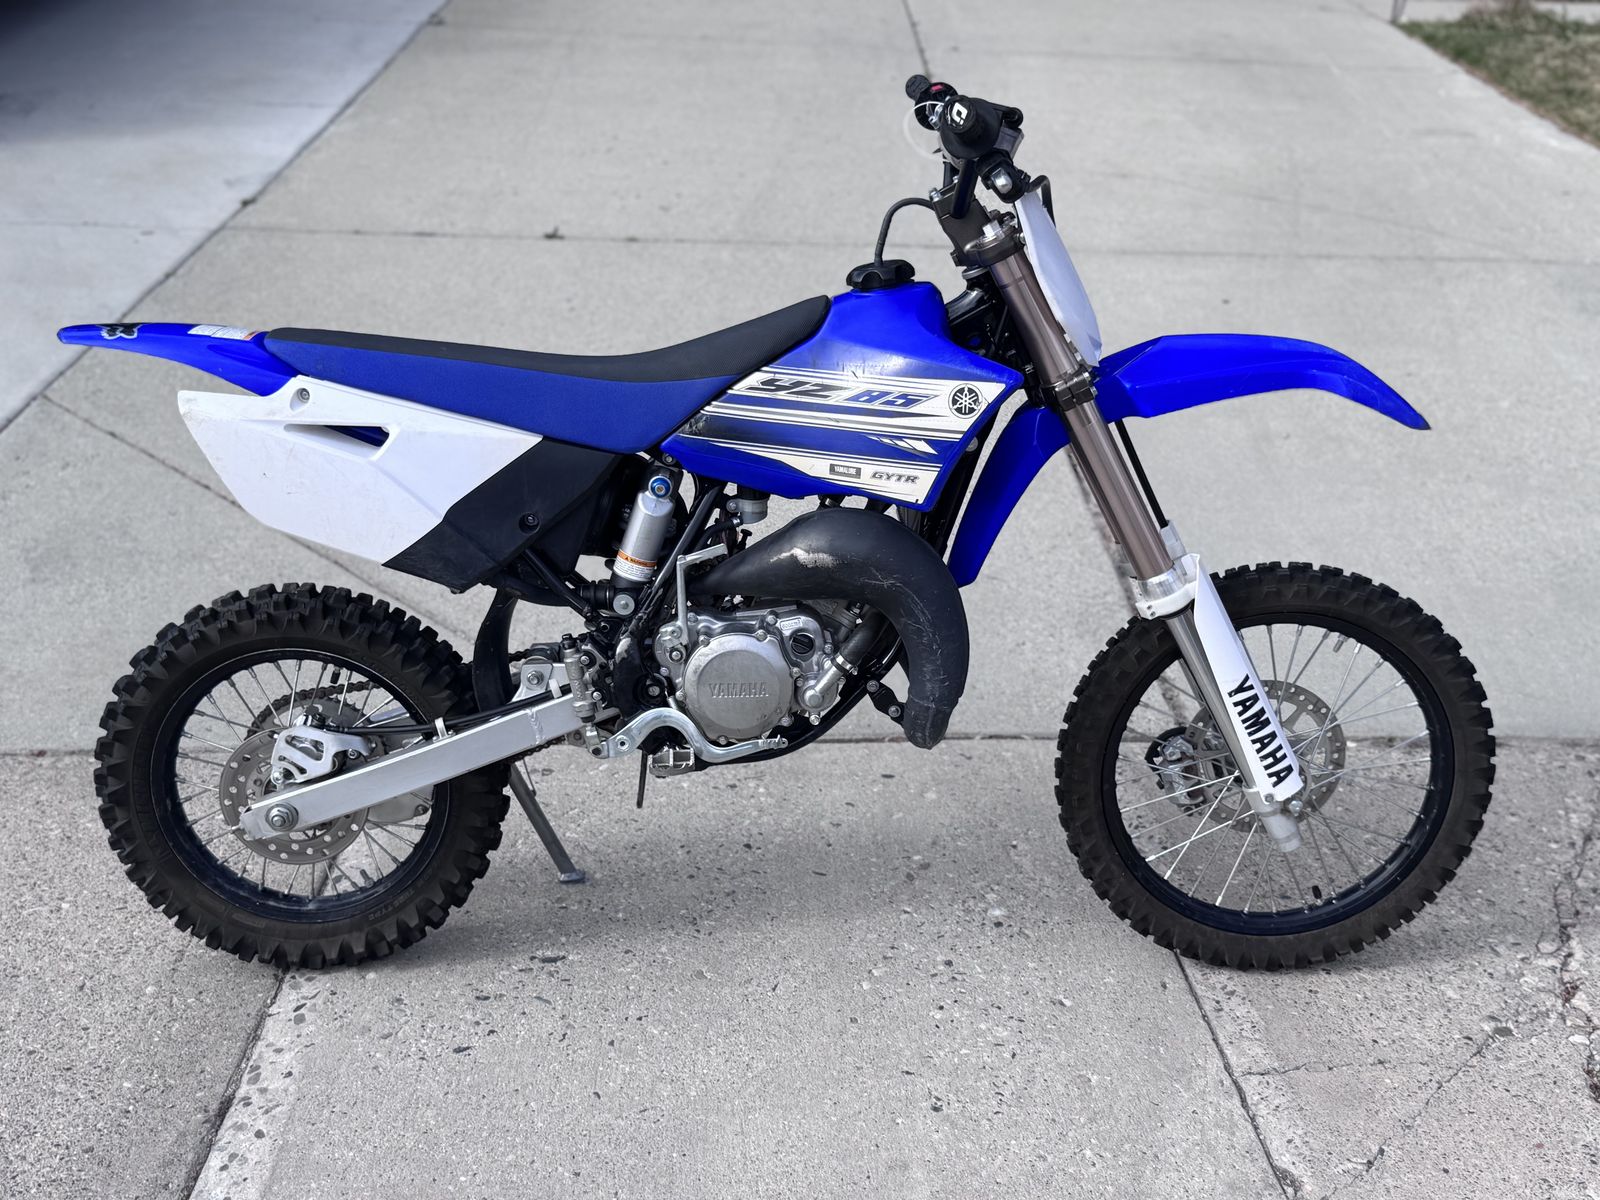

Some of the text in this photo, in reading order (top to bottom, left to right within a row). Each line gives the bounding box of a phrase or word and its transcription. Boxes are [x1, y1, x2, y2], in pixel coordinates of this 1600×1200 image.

[871, 471, 919, 484] GYTR
[708, 680, 769, 698] YAMAHA
[1227, 673, 1294, 788] YAMAHA
